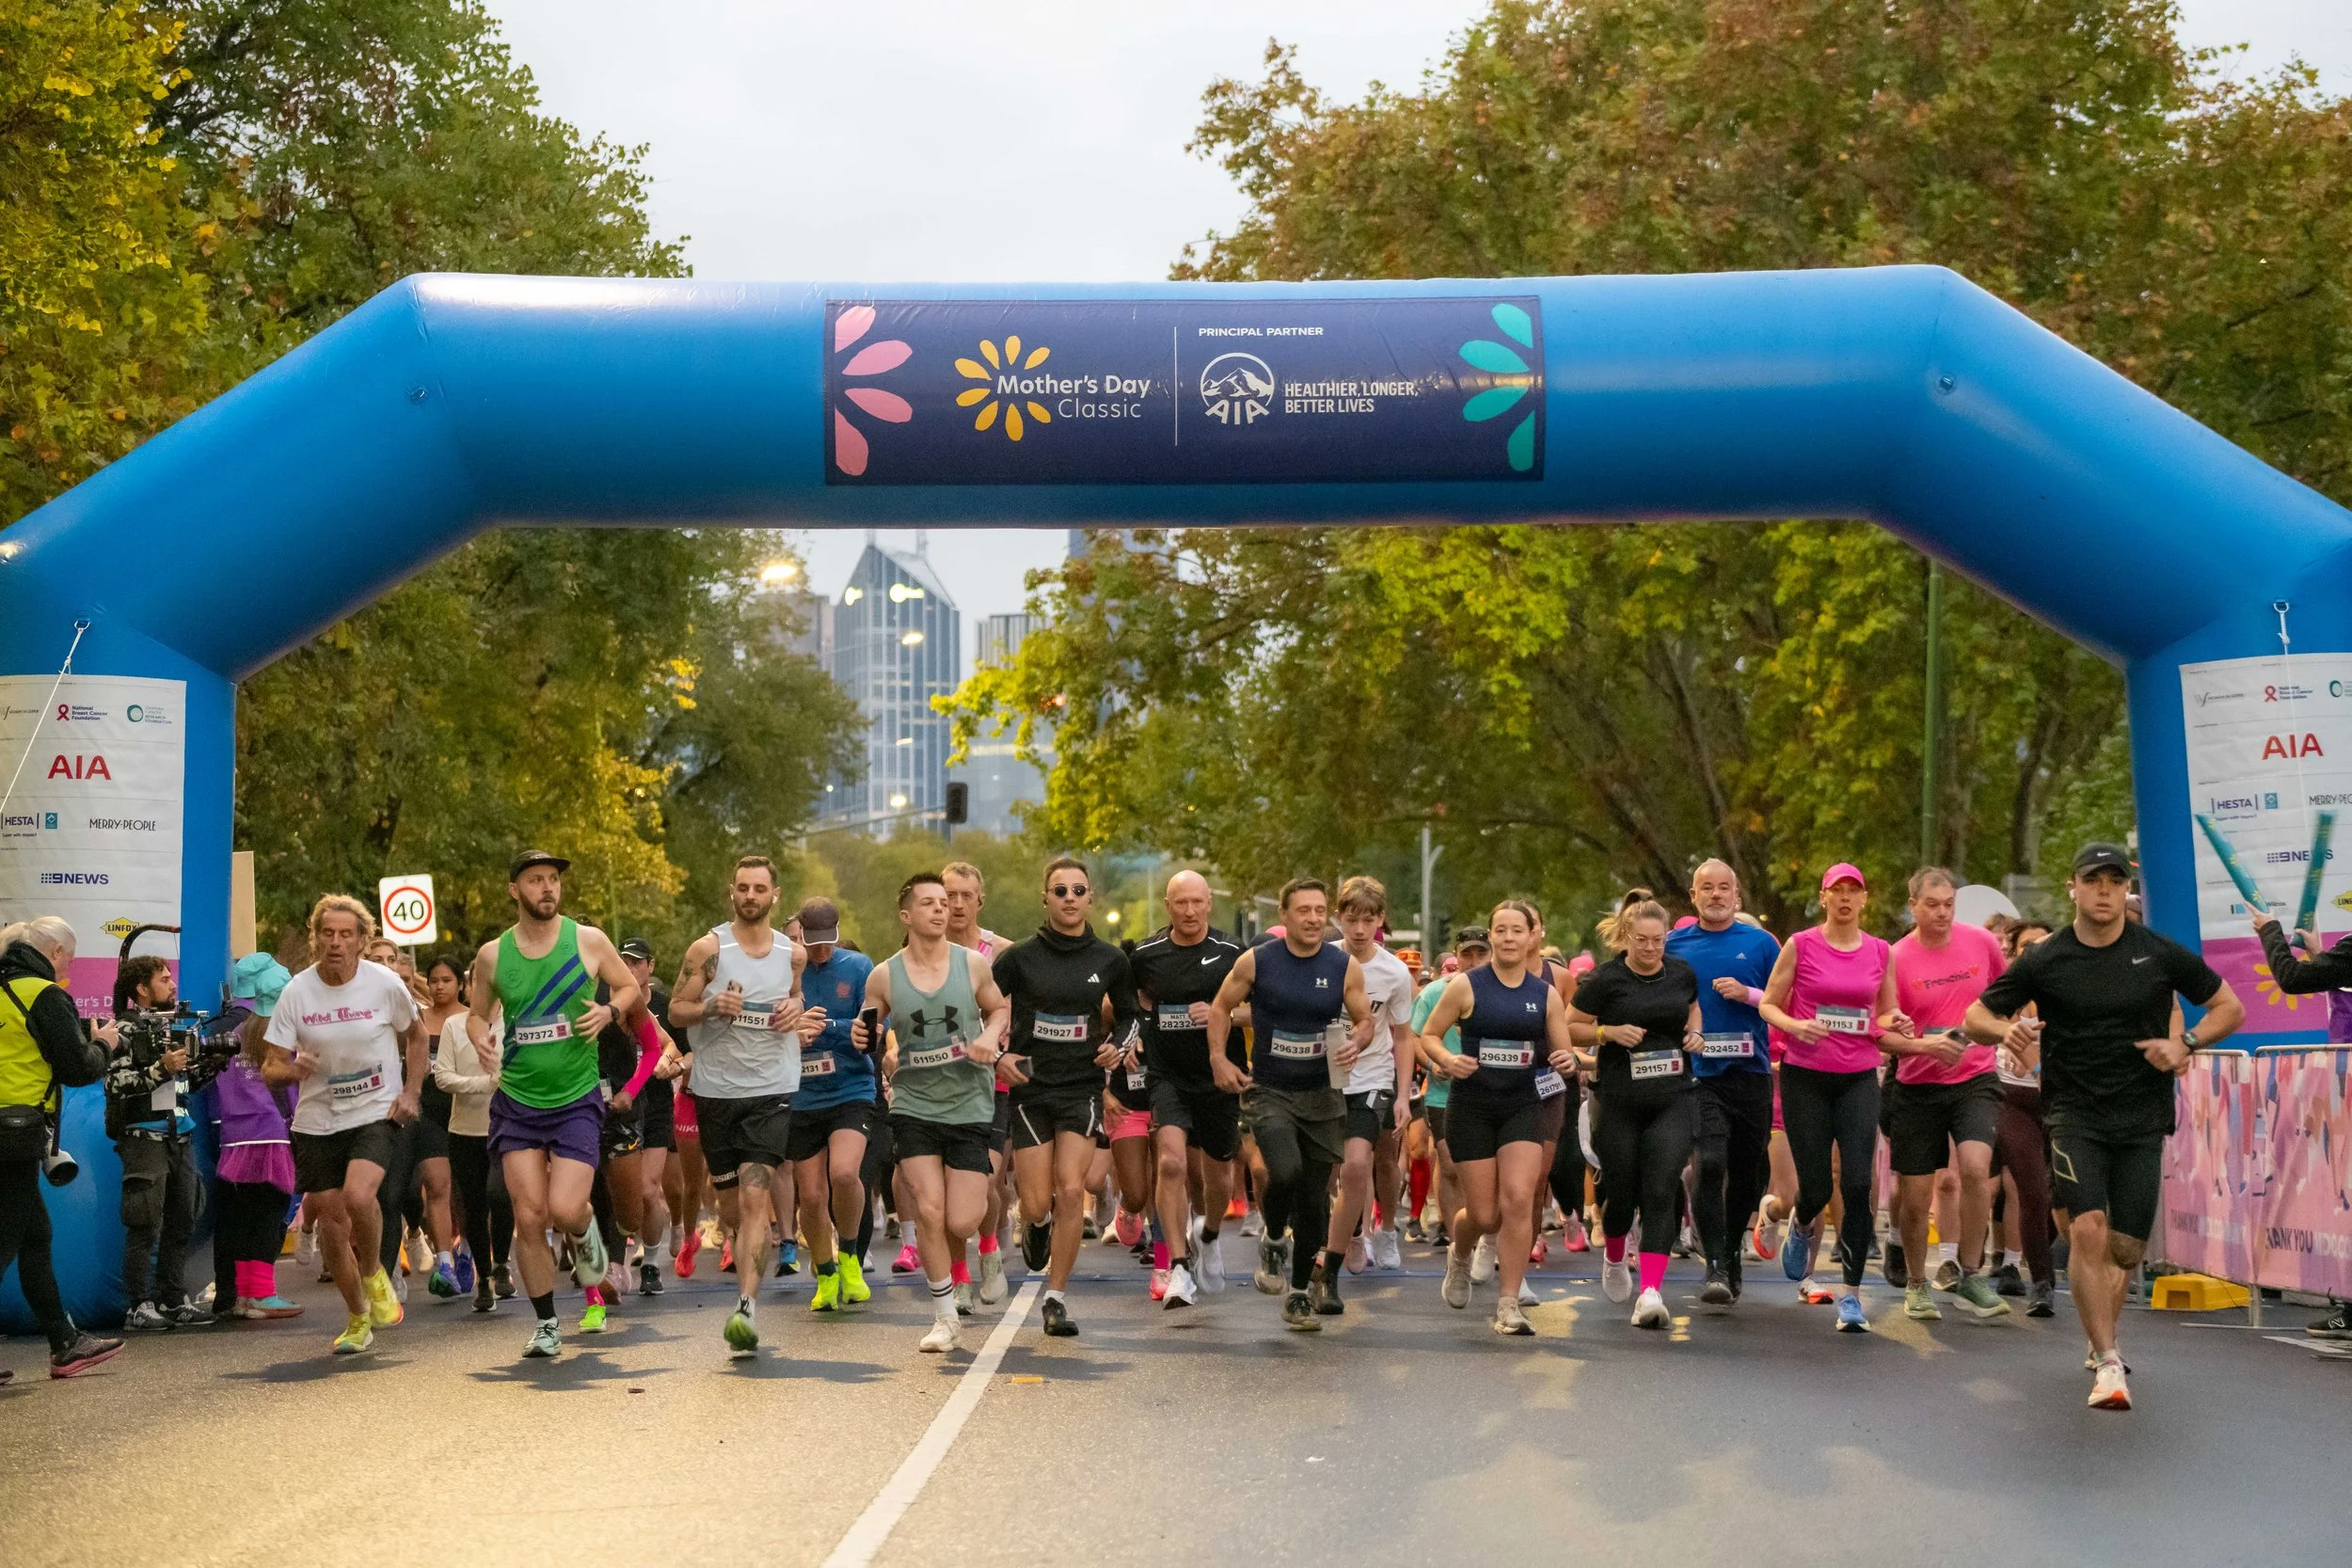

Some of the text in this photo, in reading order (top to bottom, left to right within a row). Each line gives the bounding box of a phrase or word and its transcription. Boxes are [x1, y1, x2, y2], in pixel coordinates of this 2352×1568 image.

[1199, 326, 1324, 337] PRINCIPAL PARTNER
[996, 374, 1151, 399] Mother's Day
[1285, 382, 1360, 398] HEALTHIER,
[1057, 397, 1141, 419] Classic
[1204, 399, 1270, 425] AIA
[1285, 398, 1375, 414] BETTER LIVES
[2262, 733, 2324, 760] AIA
[47, 754, 112, 781] AIA
[2217, 798, 2253, 810] HESTA
[5, 816, 35, 826] HESTA
[392, 900, 424, 922] 40
[518, 1030, 554, 1040] 297372
[1037, 1026, 1072, 1037] 291927
[1273, 1043, 1311, 1053] 296338
[1704, 1045, 1740, 1053] 292452
[913, 1052, 948, 1064] 611550
[1481, 1053, 1518, 1062] 296339
[1634, 1064, 1668, 1074] 291157
[332, 1082, 369, 1094] 298144
[2294, 1228, 2313, 1254] YOU
